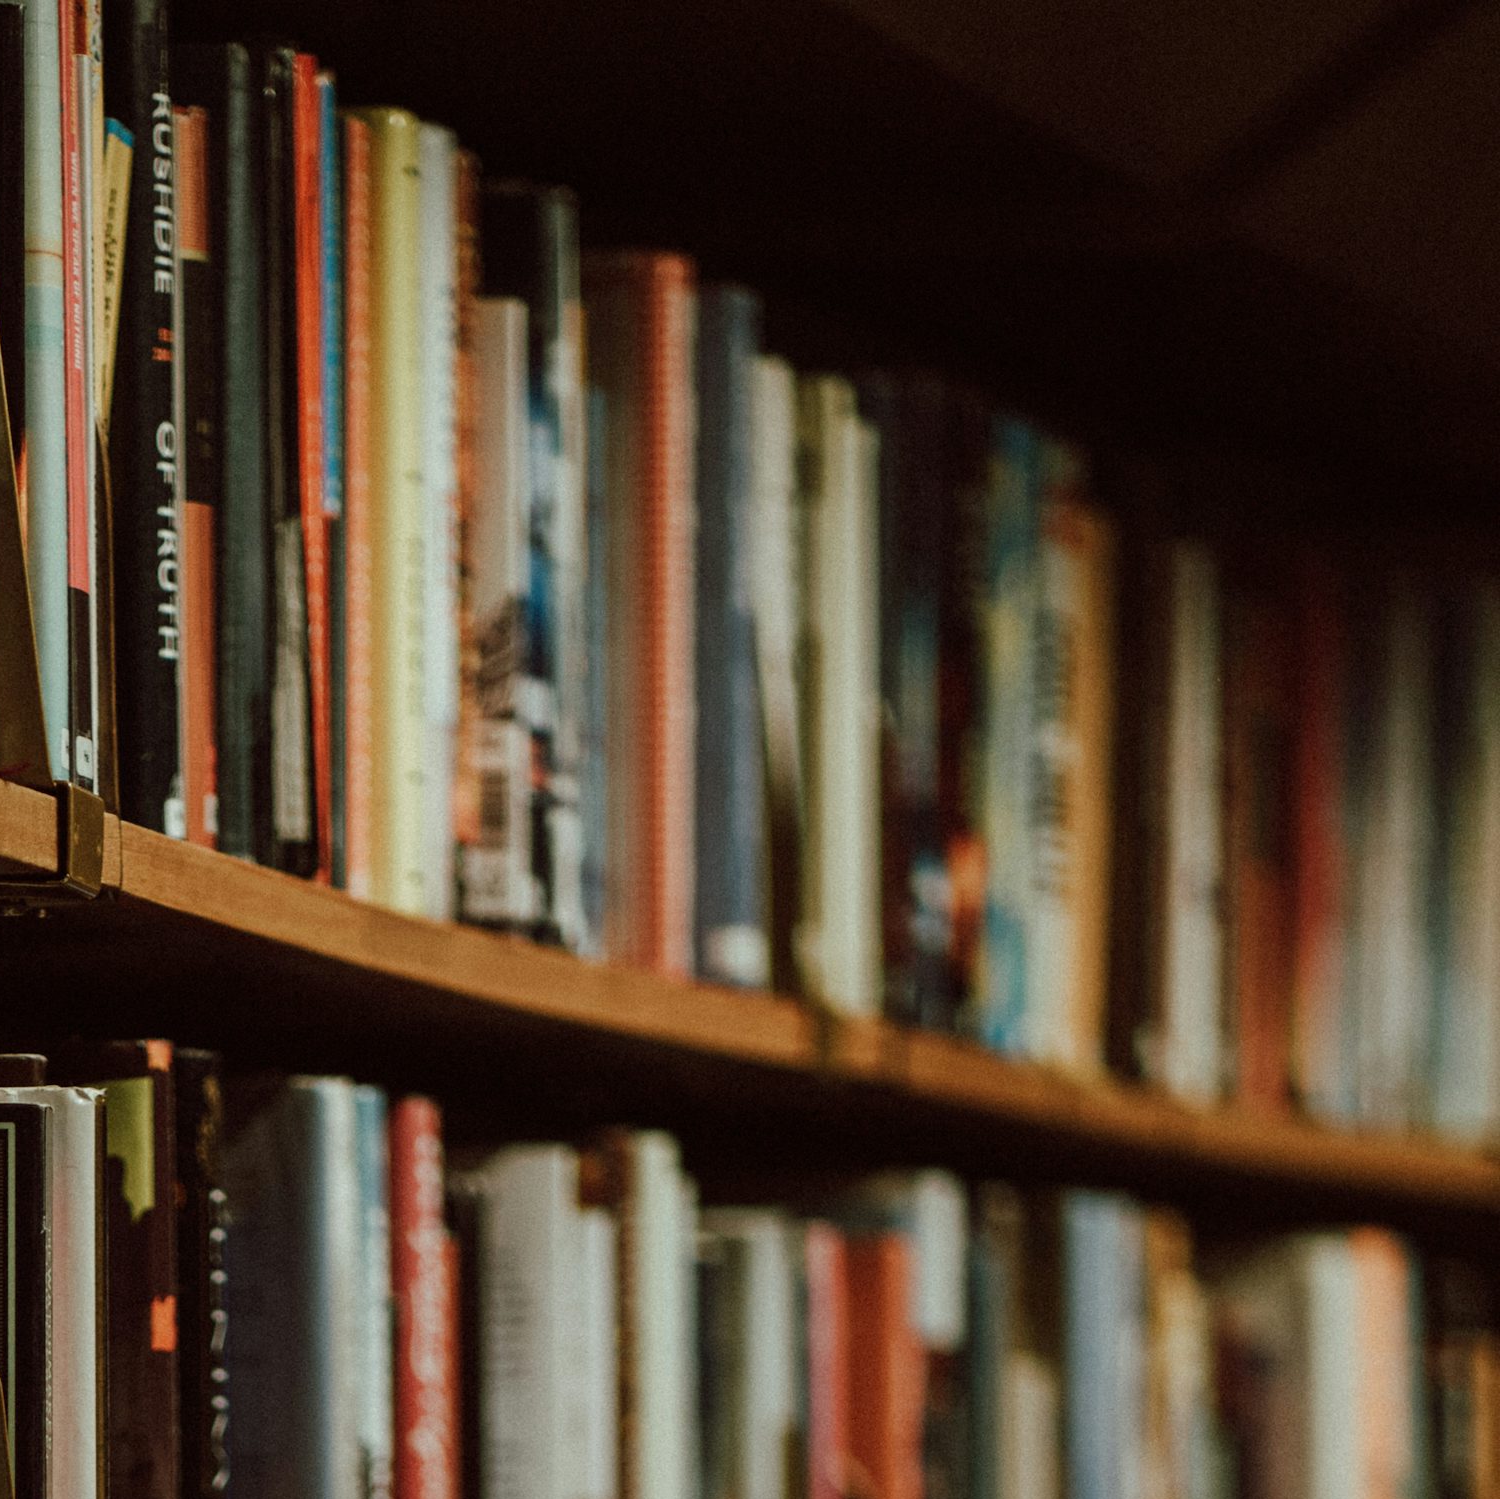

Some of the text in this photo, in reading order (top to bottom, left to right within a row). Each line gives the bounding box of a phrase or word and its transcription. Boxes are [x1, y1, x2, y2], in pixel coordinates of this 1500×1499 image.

[150, 90, 176, 295] RUSHDIE
[155, 420, 181, 661] OF TRUTH
